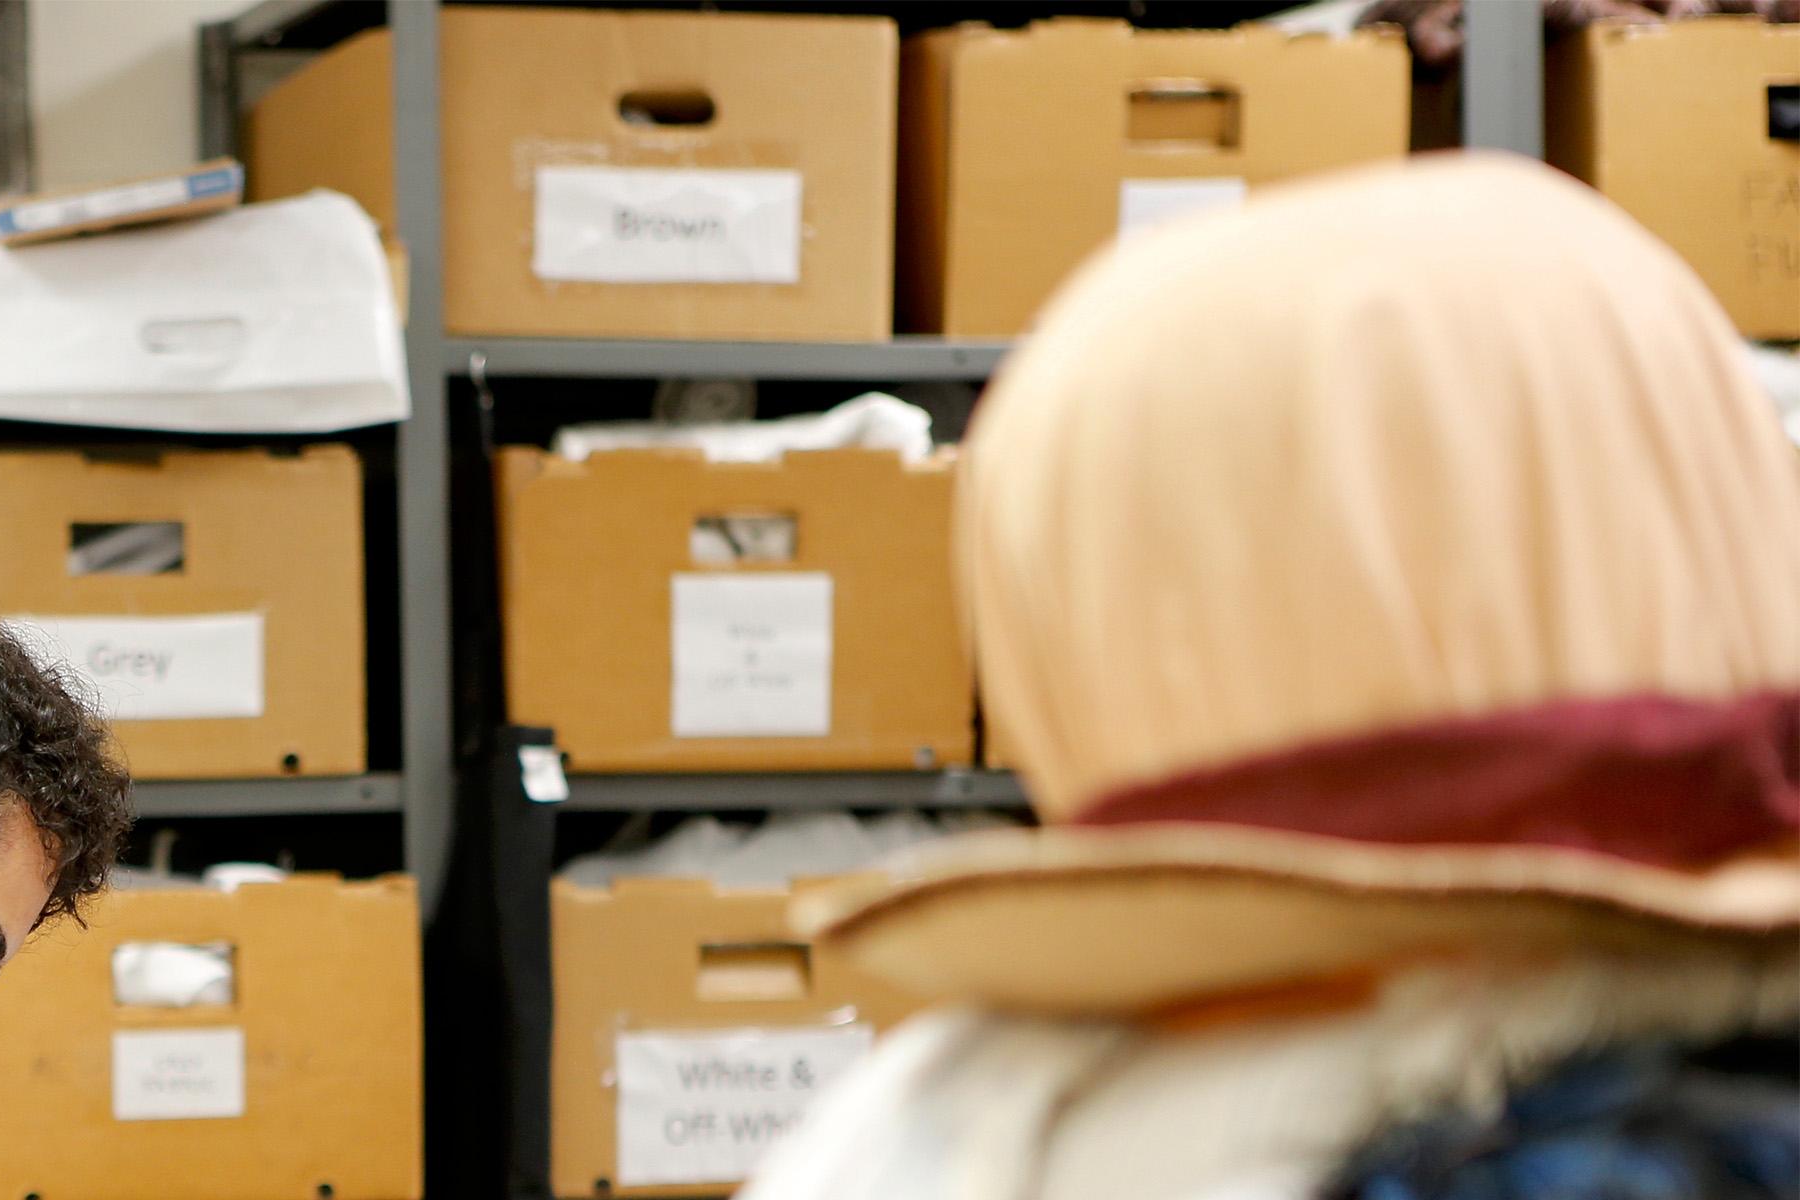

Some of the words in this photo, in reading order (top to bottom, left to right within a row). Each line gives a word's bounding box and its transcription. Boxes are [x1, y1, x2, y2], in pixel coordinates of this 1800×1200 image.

[612, 205, 727, 241] Brown
[86, 640, 172, 683] Grey
[678, 1056, 777, 1092] White
[790, 1054, 816, 1091] &
